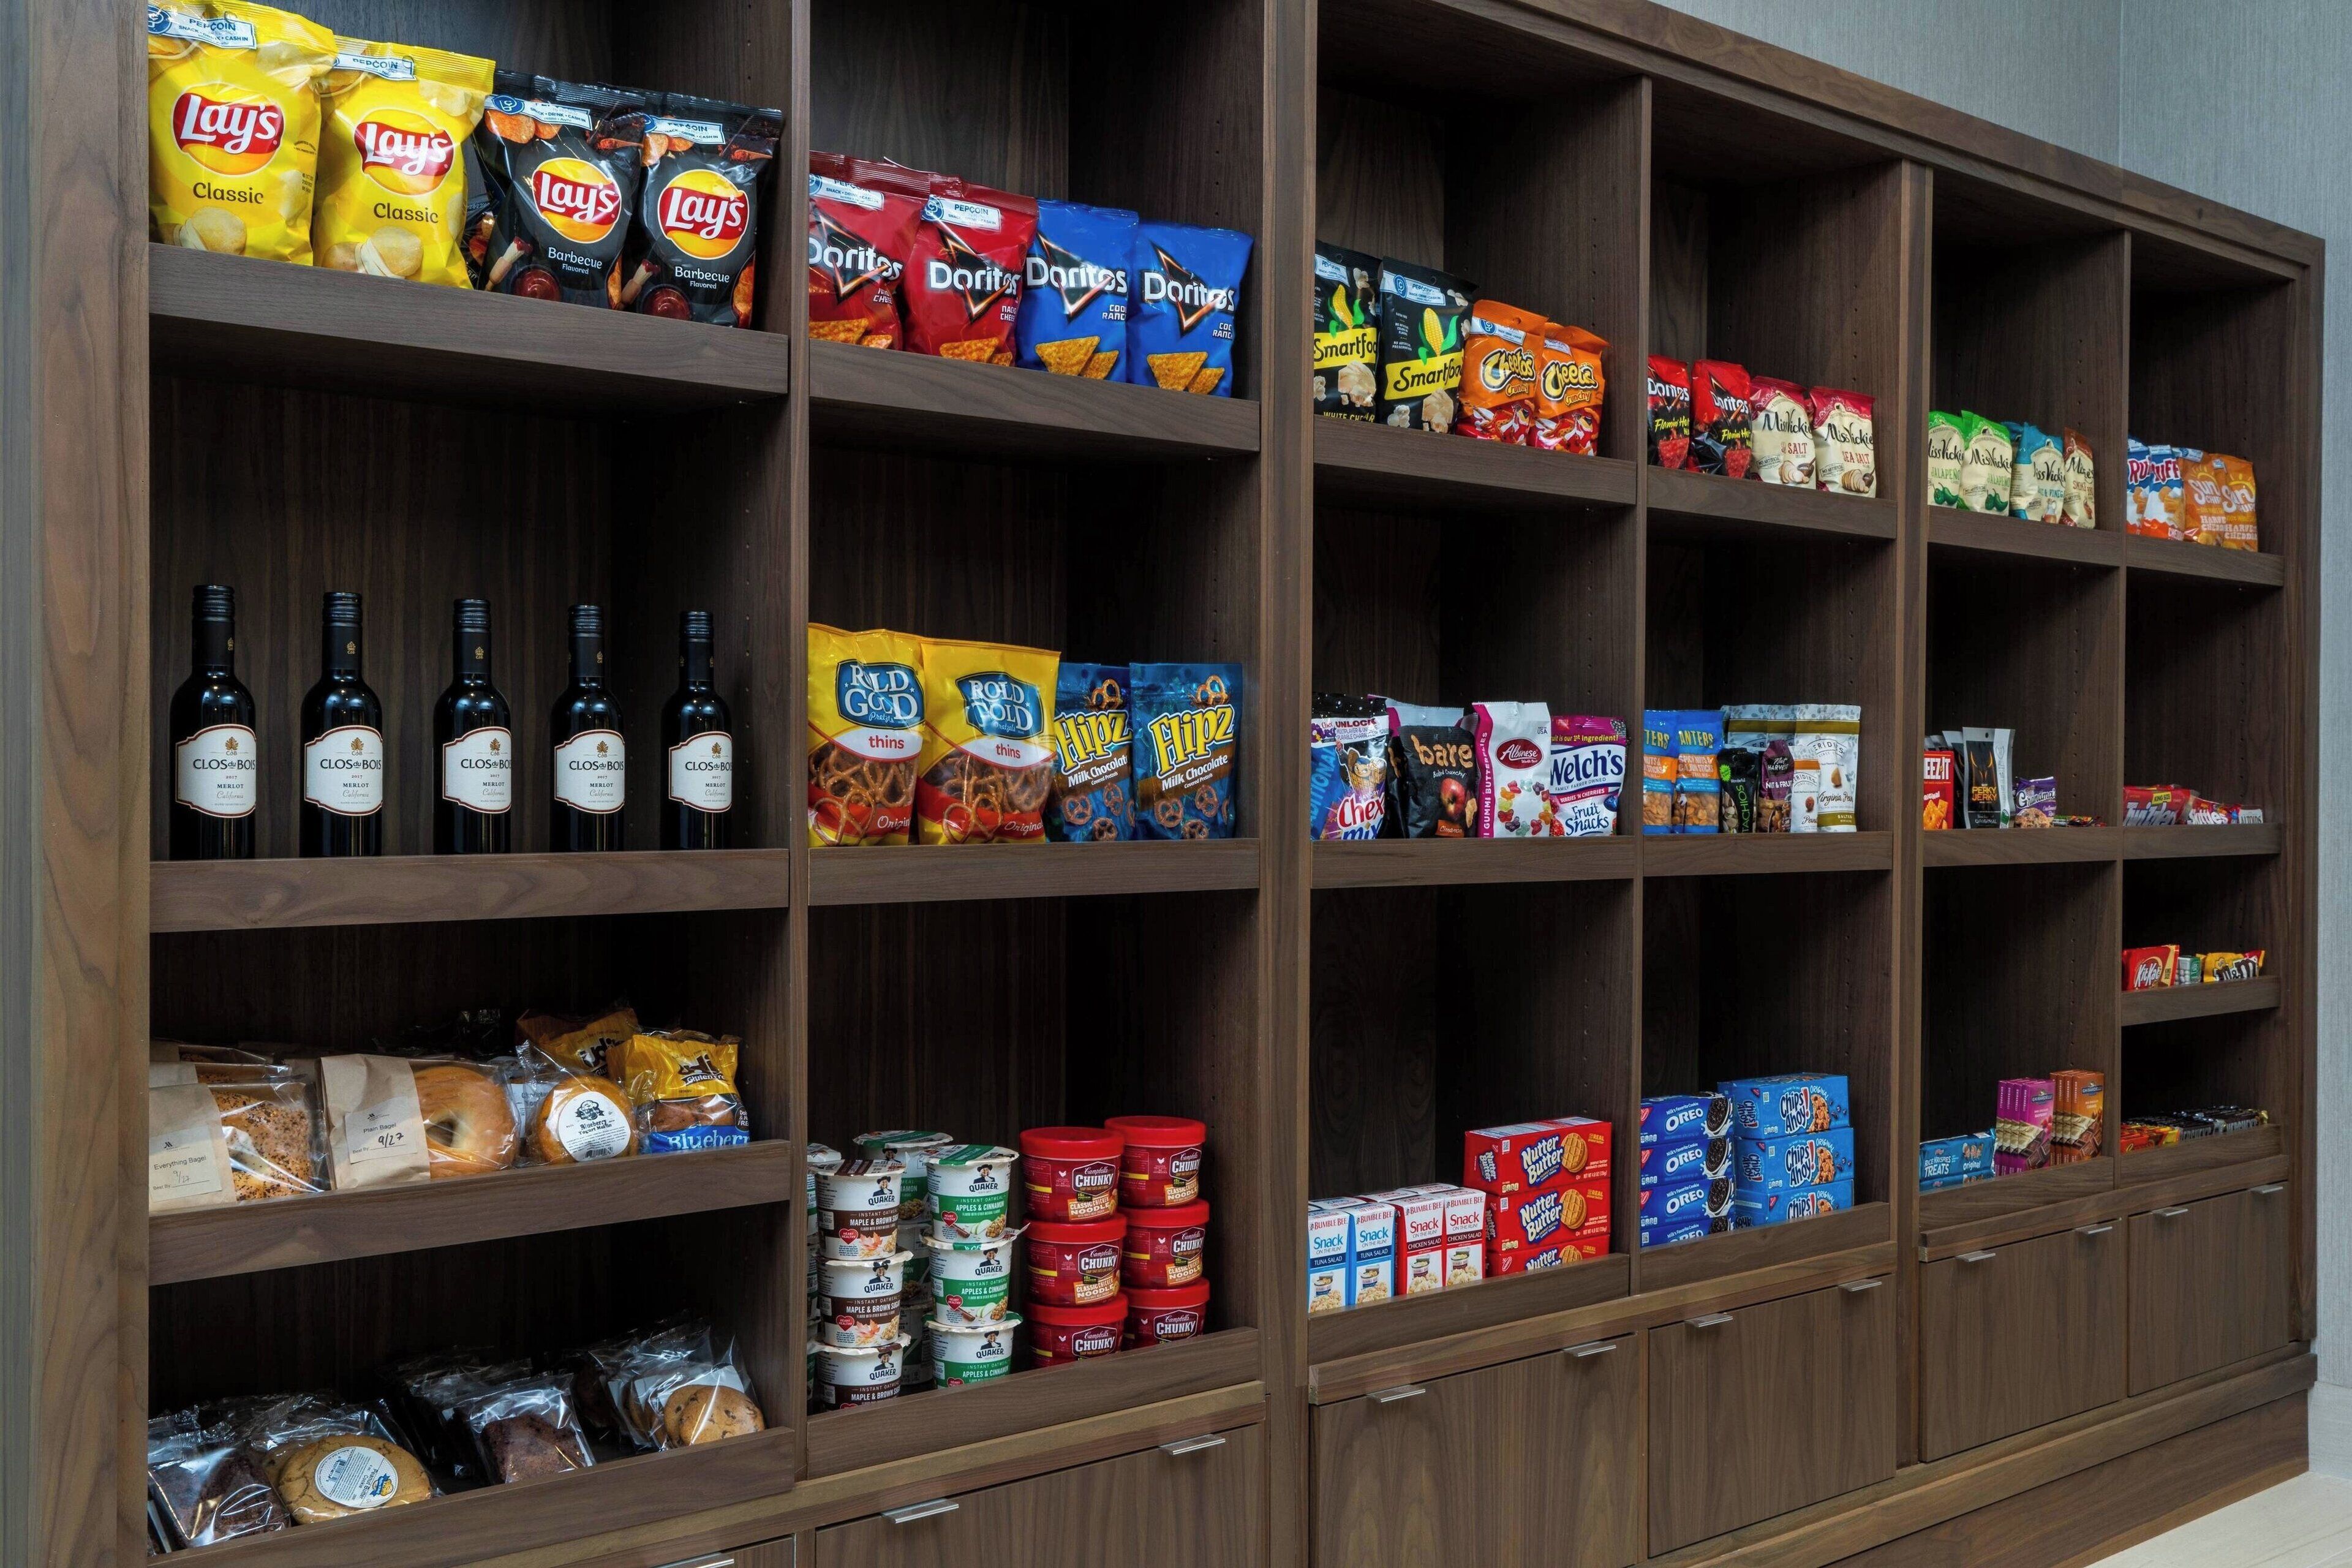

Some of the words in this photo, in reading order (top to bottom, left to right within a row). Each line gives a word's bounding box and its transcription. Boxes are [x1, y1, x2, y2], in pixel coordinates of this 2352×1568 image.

[181, 95, 279, 154] Lay's
[366, 123, 448, 176] Lay's
[193, 183, 263, 205] Classic
[540, 172, 616, 222] Lay's
[374, 203, 439, 224] Classic
[666, 188, 745, 239] Lay's
[955, 204, 989, 215] PEPCOIN
[548, 247, 602, 270] Barbecue
[809, 237, 903, 281] Doritos
[562, 263, 589, 275] Flavored
[675, 266, 729, 283] Barbecue
[1026, 257, 1127, 293] Doritos
[690, 281, 717, 289] Flavored
[929, 261, 1021, 295] Doritos
[1144, 273, 1235, 311] Doritos
[1483, 349, 1535, 387] Cheetos
[1566, 391, 1591, 405] Crunchy
[1679, 416, 1689, 427] Hot
[1788, 442, 1807, 454] SALT
[2188, 480, 2220, 505] Sun
[2221, 486, 2255, 513] Sun
[968, 680, 1025, 703] ROLD
[1336, 718, 1376, 728] UNLOCK
[869, 735, 904, 749] thins
[1054, 711, 1132, 771] Flipz
[1150, 706, 1234, 774] Flipz
[996, 743, 1020, 759] thins
[1411, 734, 1473, 768] bare
[1500, 744, 1538, 761] Albanese
[193, 759, 227, 769] CLOS
[238, 760, 255, 770] BOIS
[320, 759, 353, 769] CLOS
[461, 759, 491, 769] CLOS
[569, 761, 599, 770] CLOS
[685, 761, 714, 771] CLOS
[1068, 772, 1090, 788] Milk
[1091, 754, 1128, 776] Chocolat
[1550, 750, 1623, 786] Welch's
[1091, 775, 1106, 786] Covered
[1105, 771, 1118, 782] Pretzels
[1162, 774, 1185, 791] Milk
[1185, 754, 1228, 779] Chocolate
[1433, 769, 1444, 778] Baked
[1445, 769, 1466, 778] Crunchy
[1184, 778, 1199, 789] Covered
[1199, 772, 1213, 783] Pretzels
[217, 790, 244, 800] California
[343, 790, 369, 799] California
[590, 789, 614, 797] California
[1582, 788, 1605, 797] CHERRIES
[1338, 793, 1385, 827] Chex
[1572, 804, 1600, 820] Fruit
[1566, 816, 1609, 836] Snacks
[687, 1074, 712, 1084] Gluten
[1810, 1085, 1829, 1100] ORIGINAL
[1781, 1091, 1804, 1117] Chips
[580, 1120, 607, 1130] Blueberry
[1665, 1108, 1703, 1131] OREO
[378, 1133, 404, 1148] 9/27
[1815, 1138, 1835, 1153] ORIGINAL
[1521, 1136, 1559, 1168] Nutter
[1785, 1144, 1809, 1172] Chips
[154, 1159, 187, 1170] Everything
[1172, 1159, 1199, 1172] CHUNKY
[1527, 1148, 1563, 1185] Butter
[1665, 1149, 1703, 1173] OREO
[1963, 1160, 1981, 1170] original
[1924, 1164, 1949, 1178] TREATS
[969, 1183, 998, 1192] QUAKER
[1076, 1174, 1114, 1187] CHUNKY
[1167, 1186, 1185, 1195] CLASSIC
[1817, 1190, 1836, 1205] ORIGINAL
[869, 1195, 895, 1205] QUAKER
[984, 1201, 1005, 1210] CINNAMON
[1070, 1201, 1093, 1210] CLASSIC
[1450, 1199, 1472, 1208] BUMBLE
[1667, 1189, 1704, 1214] OREO
[1071, 1202, 1110, 1215] NOODLE
[1410, 1205, 1431, 1215] BUMBLE
[1432, 1202, 1442, 1210] BEE
[1520, 1193, 1558, 1224] Nutter
[876, 1216, 892, 1224] BROWN
[1360, 1213, 1381, 1224] BUMBLE
[1382, 1210, 1393, 1219] BEE
[1450, 1212, 1479, 1226] Snack
[1526, 1205, 1562, 1242] Butter
[1314, 1219, 1336, 1230] BUMBLE
[1410, 1218, 1438, 1234] Snack
[1314, 1234, 1343, 1250] Snack
[1360, 1227, 1389, 1243] Snack
[1427, 1238, 1441, 1246] SALAD
[1080, 1255, 1117, 1270] CHUNKY
[975, 1265, 1002, 1276] QUAKER
[1169, 1266, 1186, 1275] CLASSIC
[864, 1283, 893, 1293] QUAKER
[1077, 1285, 1098, 1294] CLASSIC
[1077, 1286, 1115, 1297] NOODLE
[873, 1303, 890, 1313] BROWN
[1156, 1321, 1196, 1335] CHUNKY
[1076, 1337, 1115, 1352] CHUNKY
[976, 1348, 1004, 1360] QUAKER
[870, 1368, 896, 1380] QUAKER
[876, 1389, 894, 1400] BROWN
